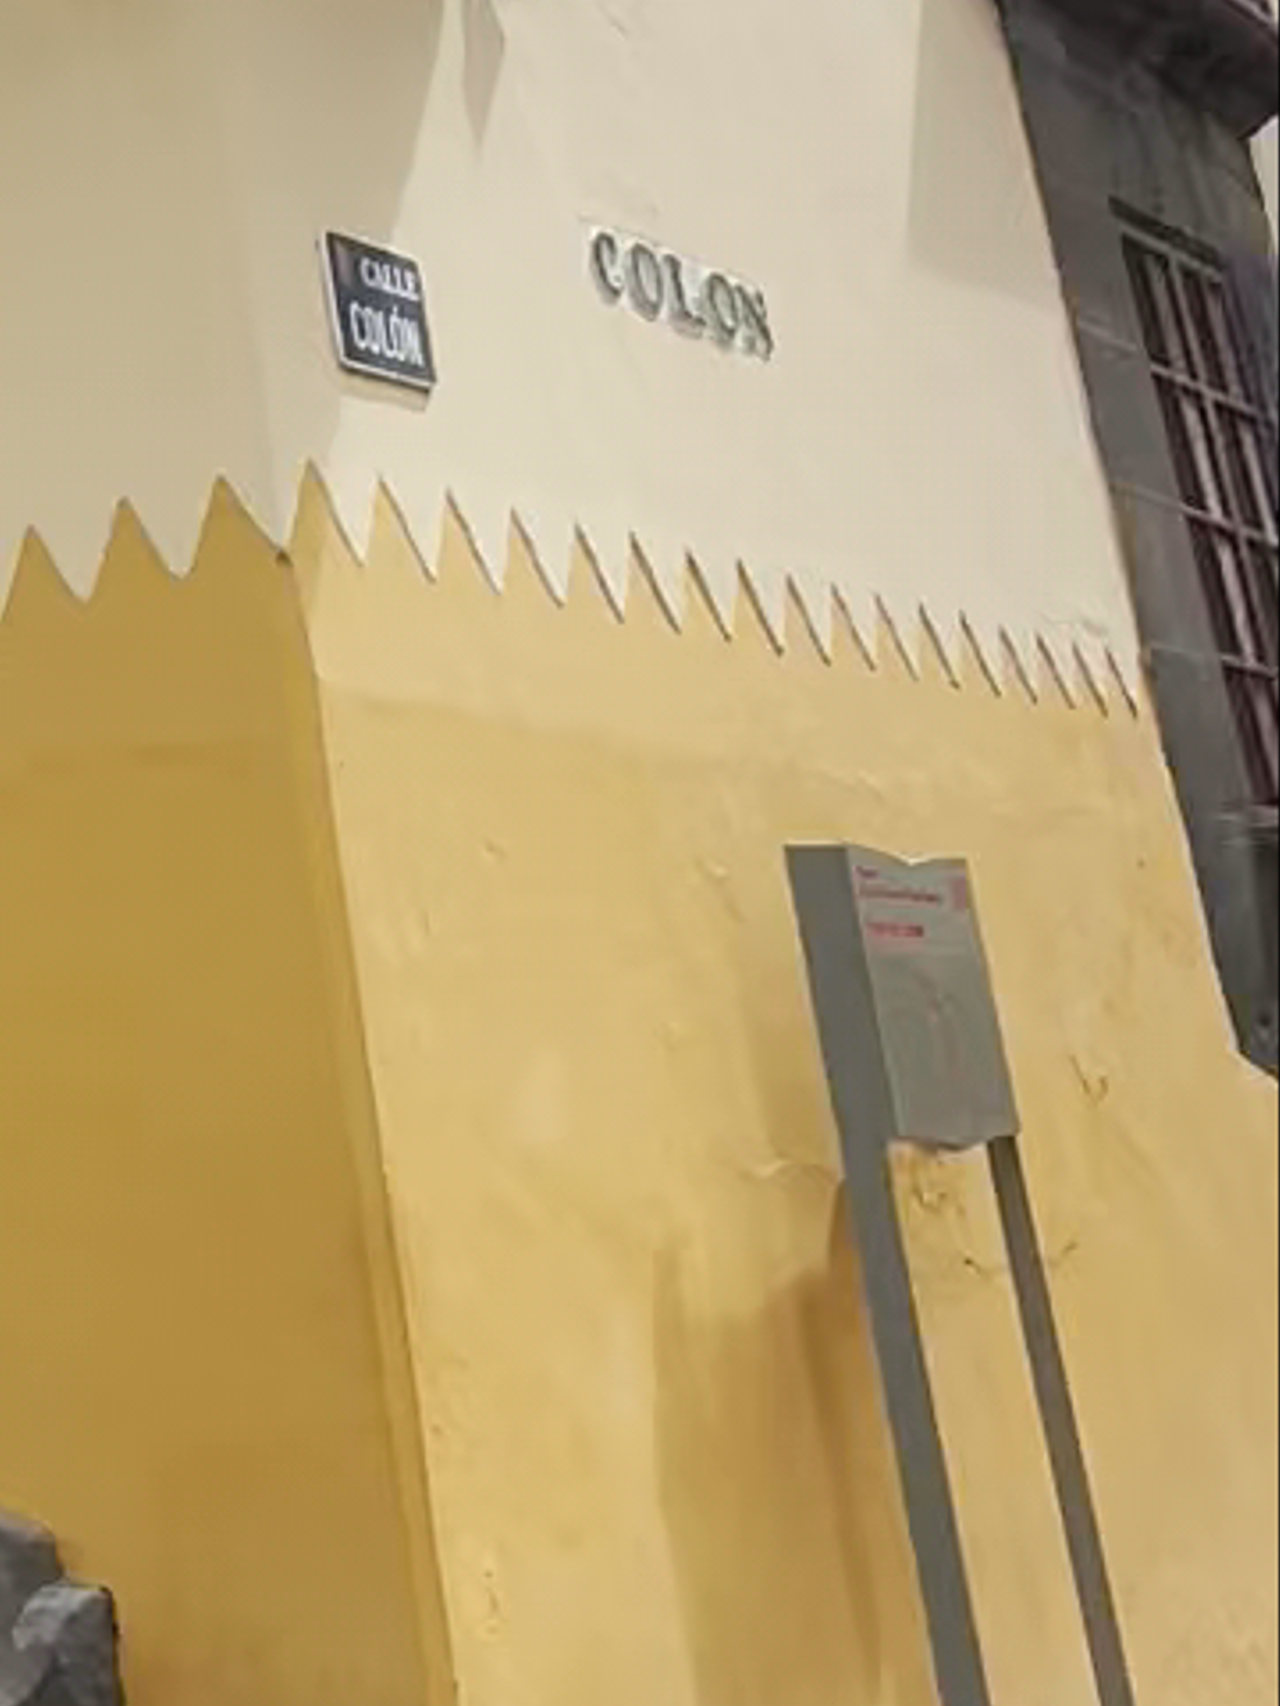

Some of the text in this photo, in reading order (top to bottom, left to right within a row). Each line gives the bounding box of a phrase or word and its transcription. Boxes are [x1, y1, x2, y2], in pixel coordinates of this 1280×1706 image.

[360, 257, 420, 302] CALLE
[592, 232, 774, 362] COLON
[349, 301, 425, 369] COLÓN
